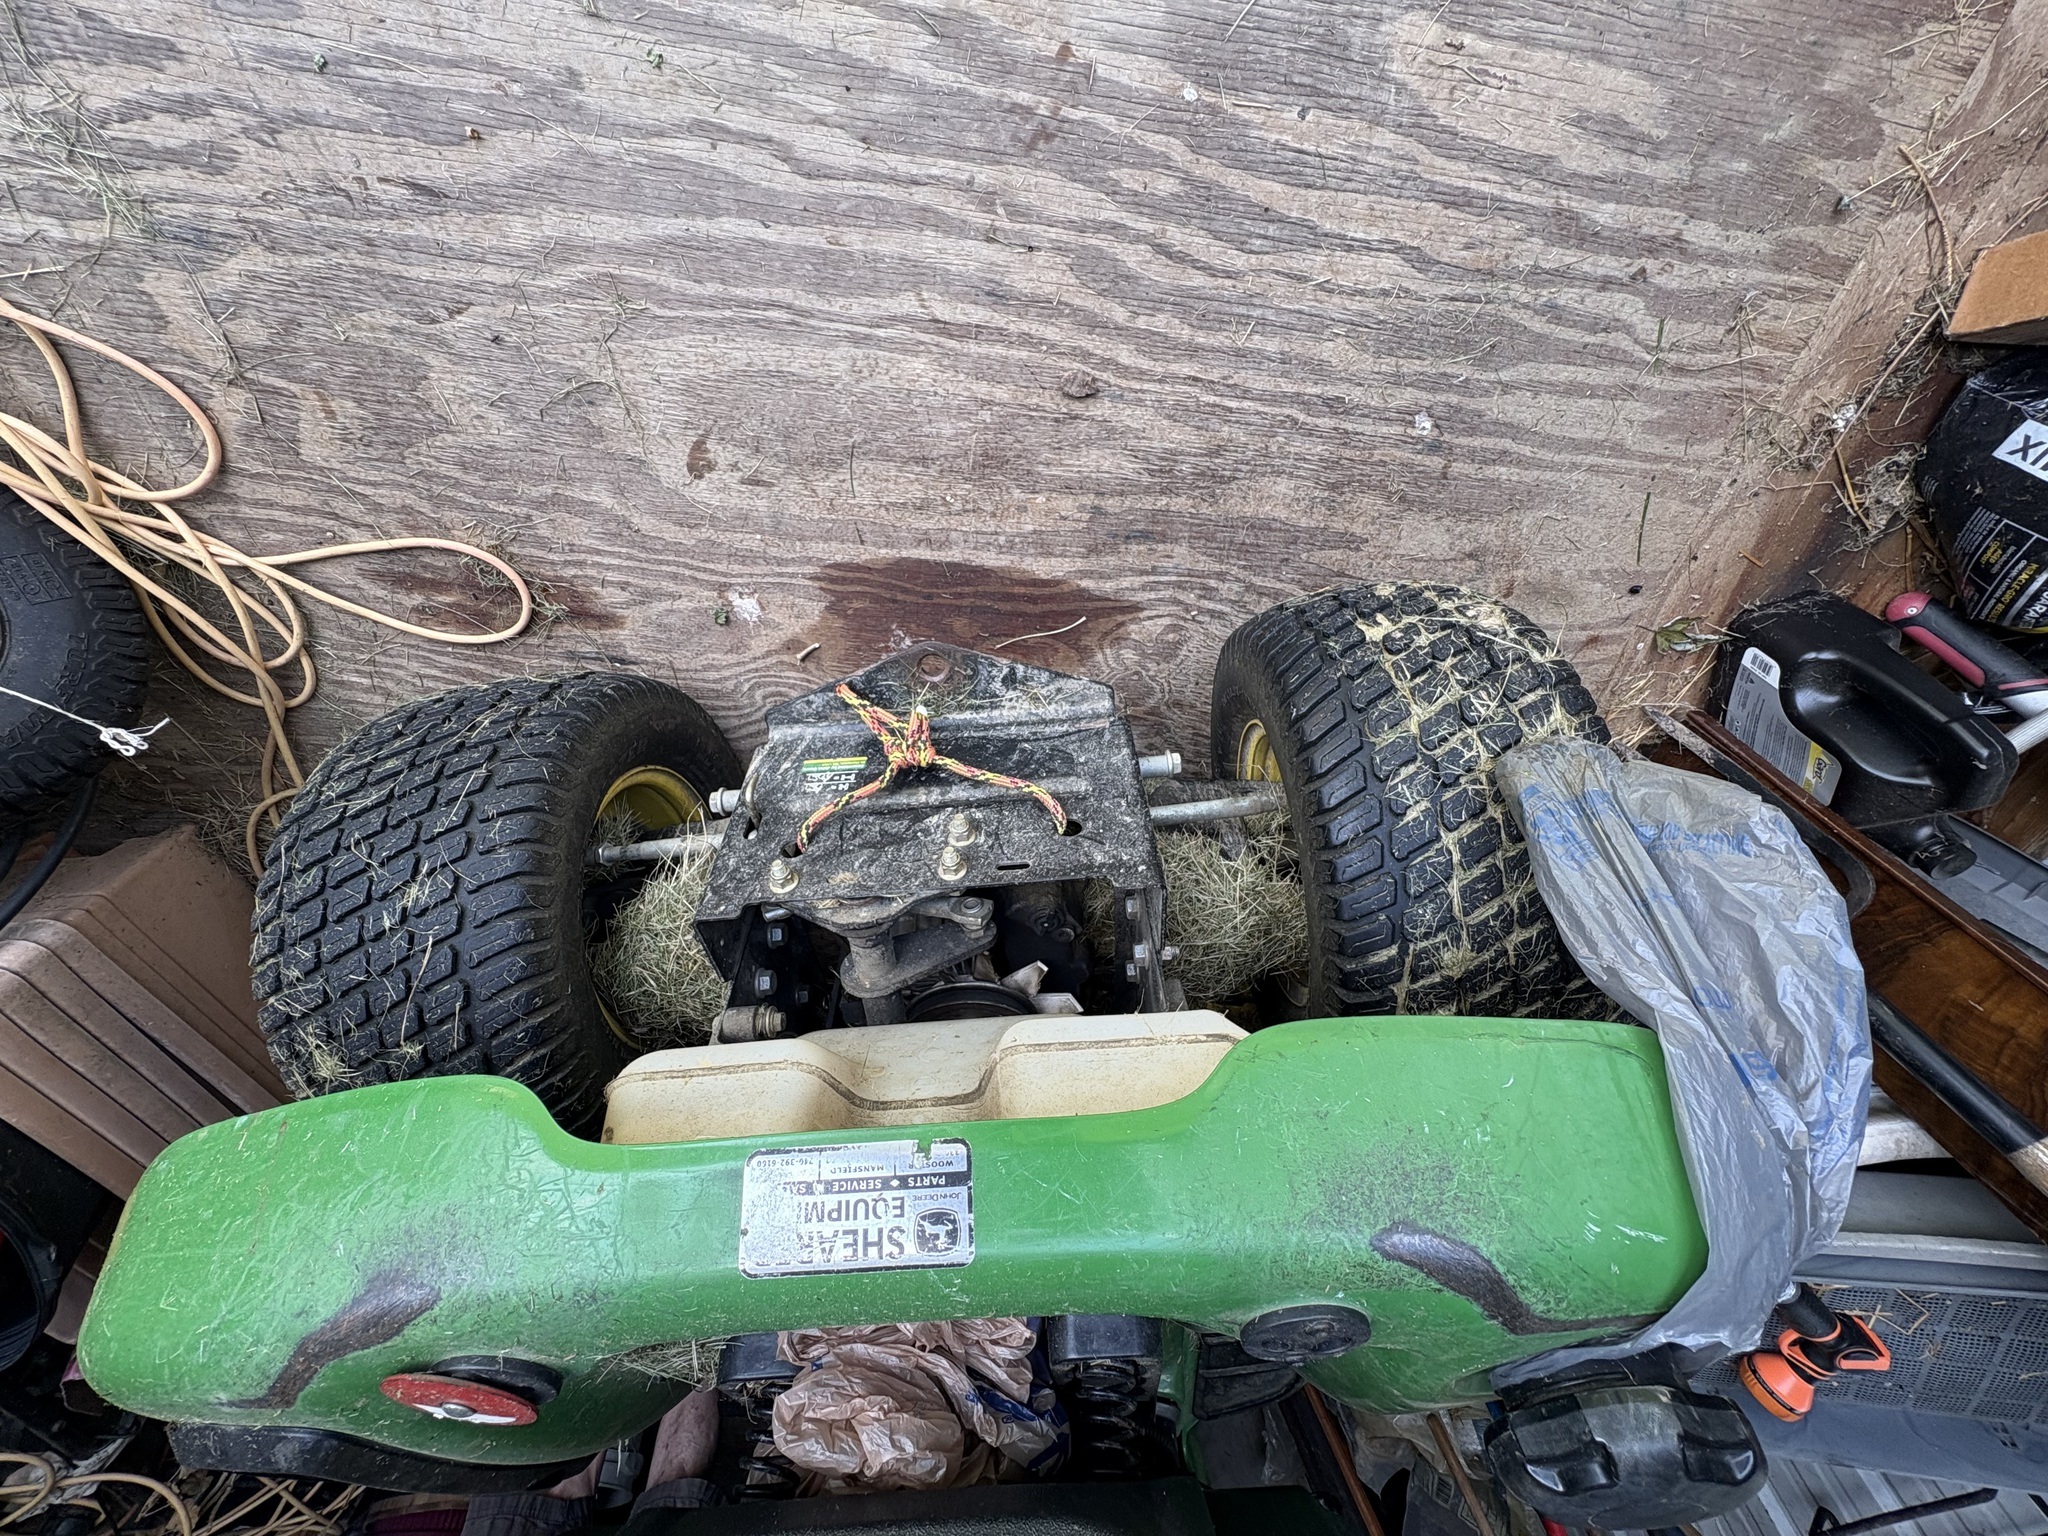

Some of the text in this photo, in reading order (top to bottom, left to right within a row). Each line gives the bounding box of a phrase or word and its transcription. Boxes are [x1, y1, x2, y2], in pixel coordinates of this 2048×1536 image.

[2005, 433, 2048, 472] IX
[832, 1178, 882, 1191] SERVICE
[908, 1174, 946, 1187] PARTS
[796, 1192, 906, 1223] EQUIPM
[939, 1191, 962, 1201] JOHN
